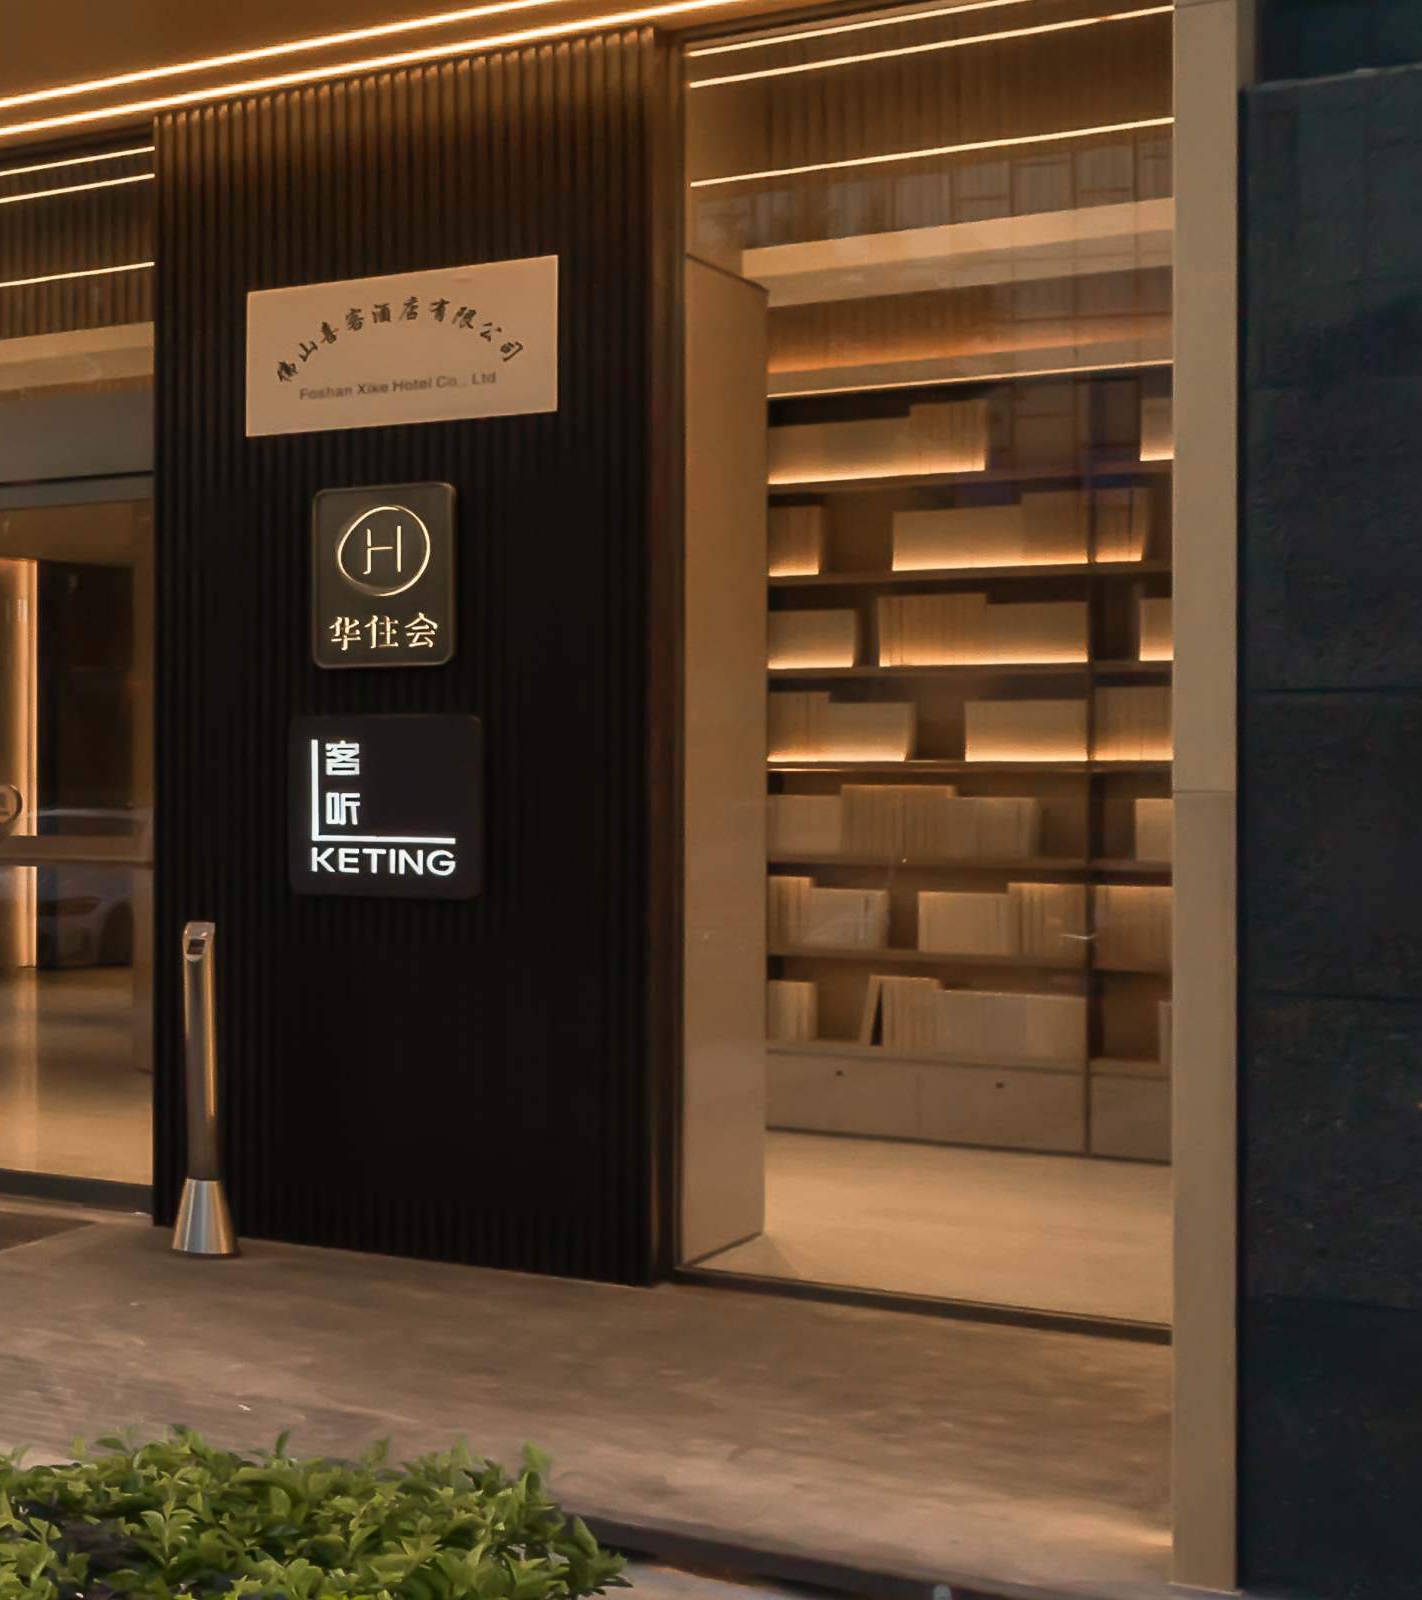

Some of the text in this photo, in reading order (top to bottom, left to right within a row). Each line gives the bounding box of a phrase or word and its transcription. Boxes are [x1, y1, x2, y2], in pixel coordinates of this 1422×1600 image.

[300, 385, 353, 400] Foshan
[357, 382, 389, 395] Xike
[393, 377, 432, 392] Hotel
[472, 371, 496, 385] Ltd
[329, 612, 439, 651] 华住会
[325, 740, 361, 826] 客听
[310, 846, 457, 876] KETING
